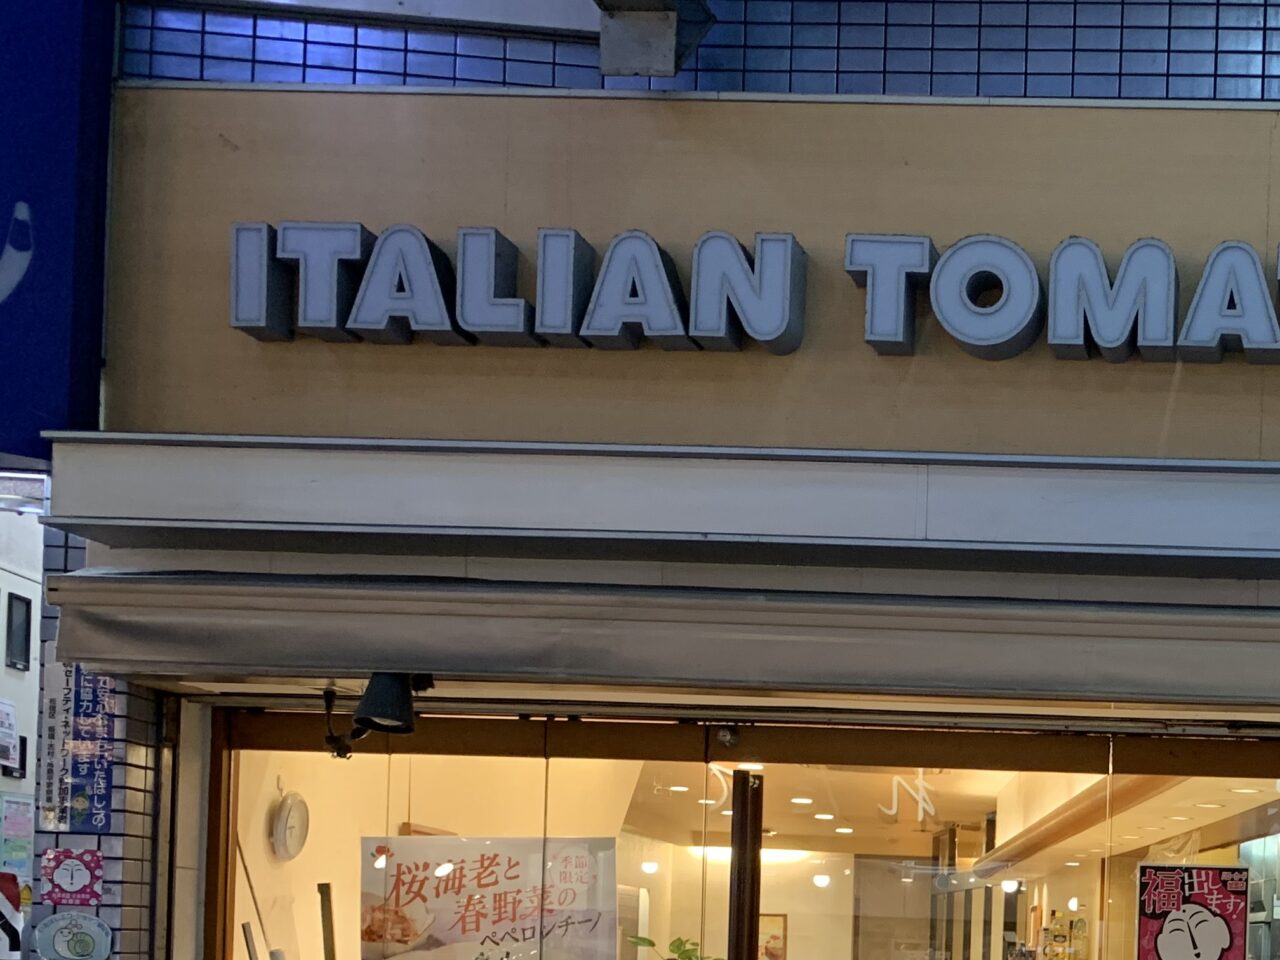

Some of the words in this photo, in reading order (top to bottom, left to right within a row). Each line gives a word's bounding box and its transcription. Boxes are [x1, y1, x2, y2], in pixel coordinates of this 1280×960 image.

[229, 220, 806, 354] ITALIAN
[387, 853, 520, 909] 桜海老と
[448, 884, 577, 935] 春野菜の
[480, 912, 602, 947] ペペロンチーノ
